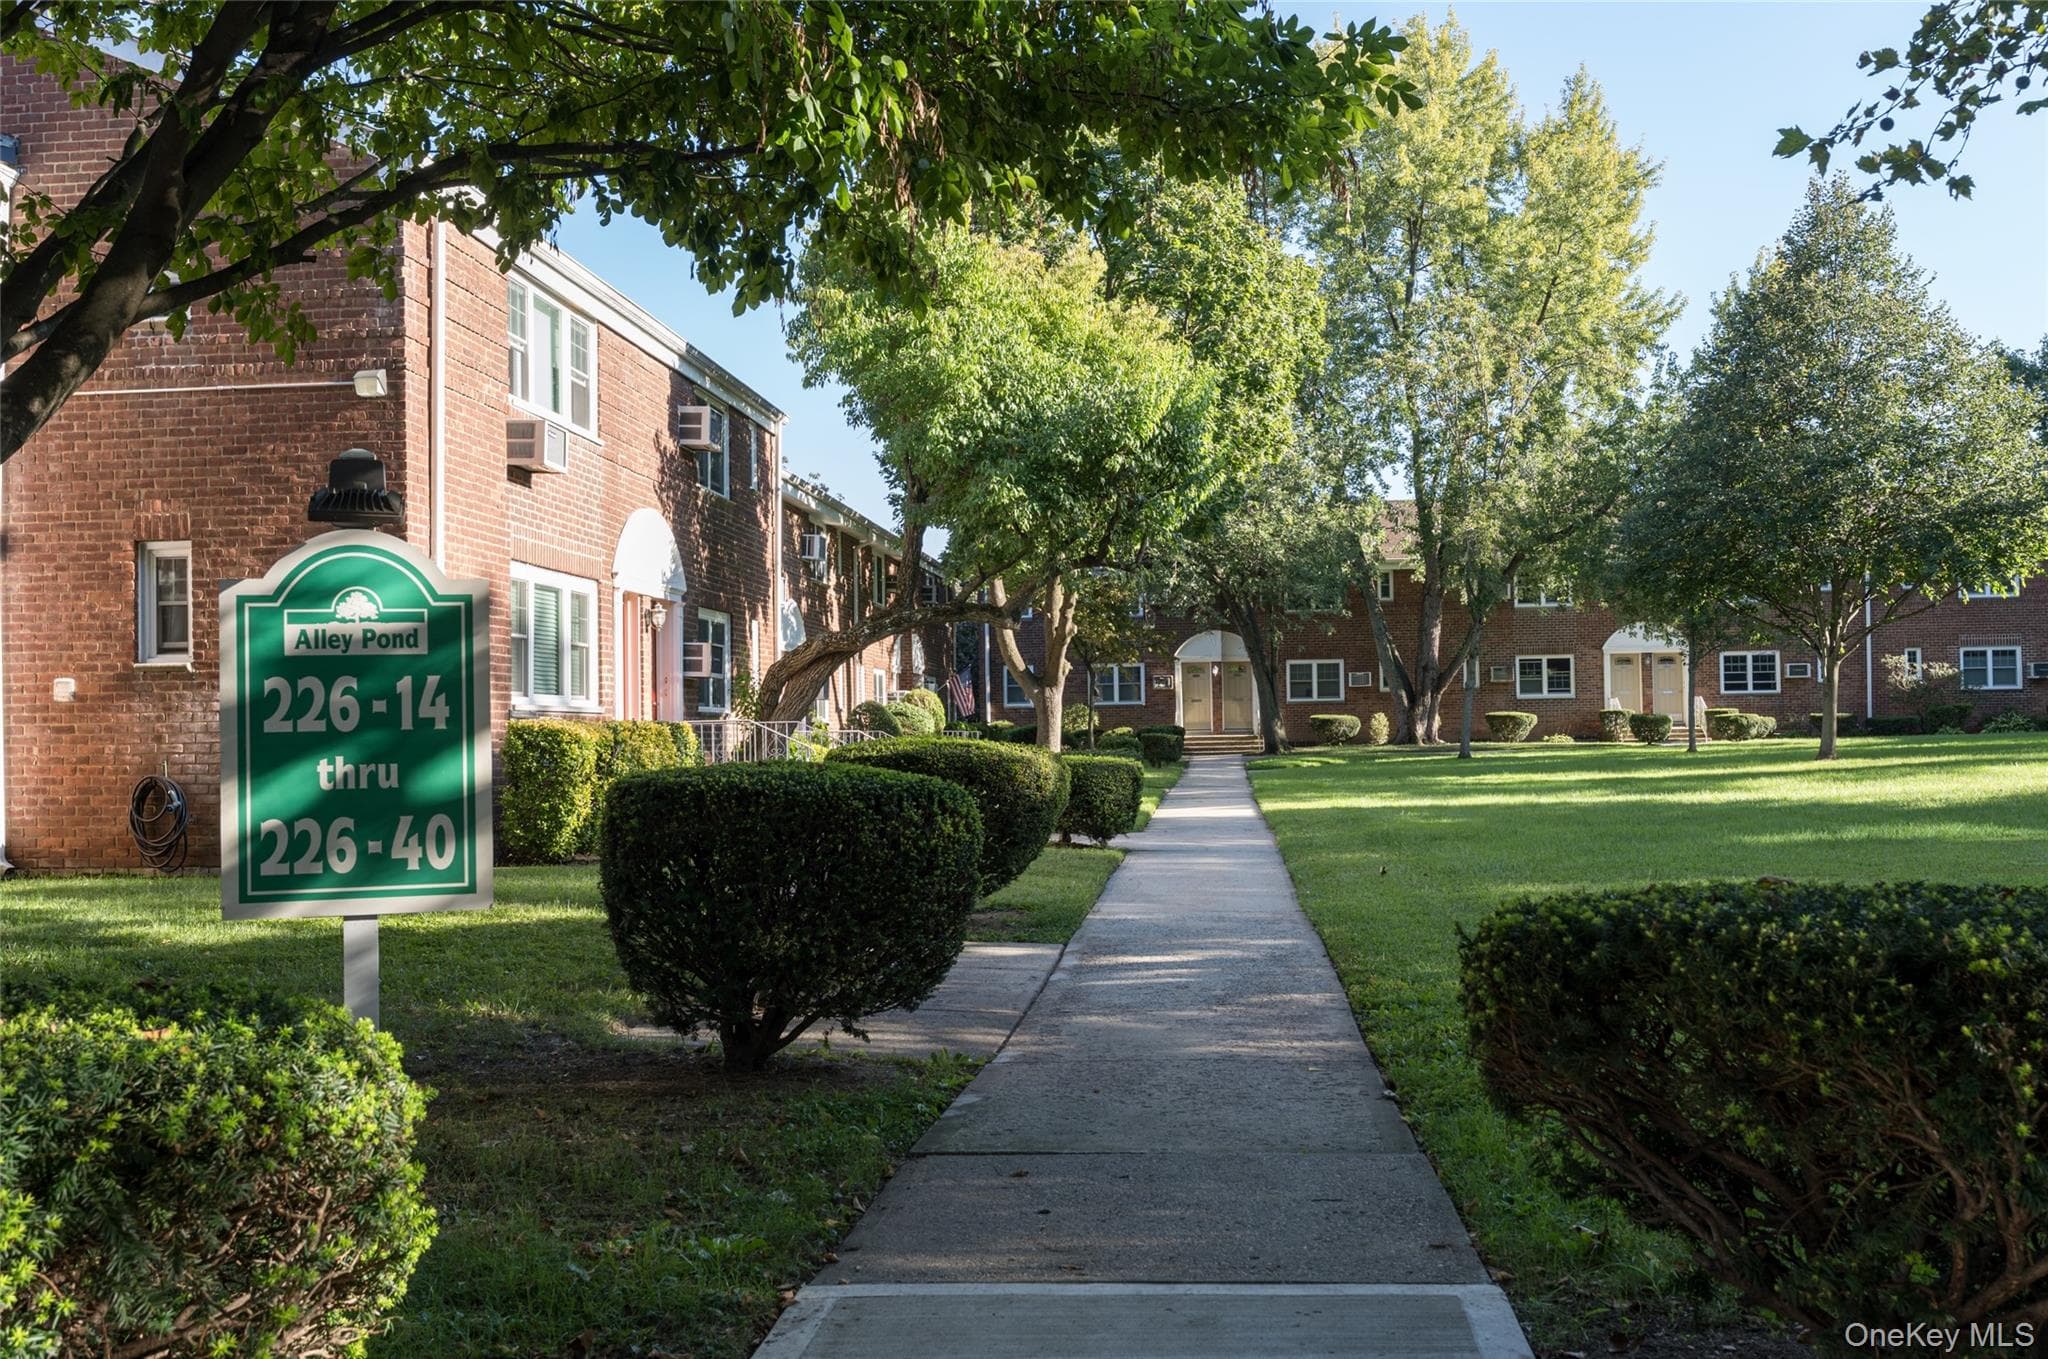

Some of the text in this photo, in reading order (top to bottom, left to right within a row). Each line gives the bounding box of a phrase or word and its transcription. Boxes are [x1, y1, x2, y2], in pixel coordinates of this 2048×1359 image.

[294, 628, 419, 654] Alley Pond
[316, 756, 399, 791] thru
